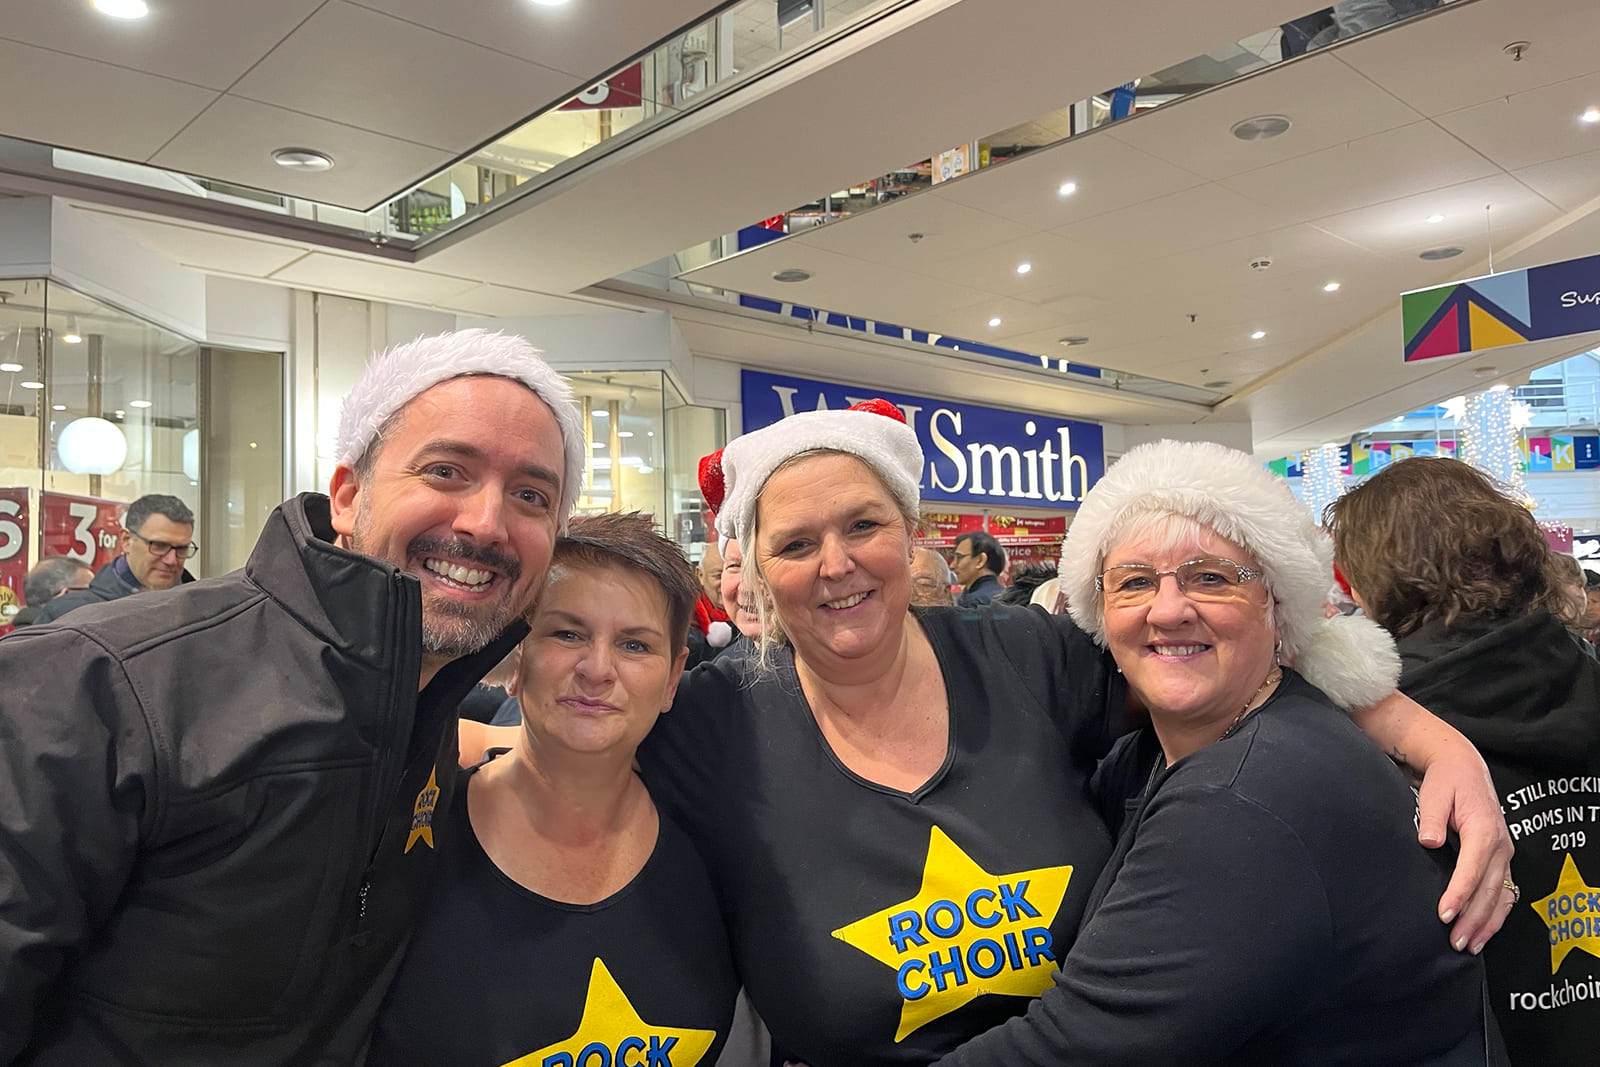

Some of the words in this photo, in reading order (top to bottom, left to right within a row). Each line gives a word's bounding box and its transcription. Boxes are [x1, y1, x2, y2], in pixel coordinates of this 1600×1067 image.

[98, 529, 118, 549] for
[1506, 782, 1547, 811] STILL
[1509, 808, 1564, 841] PROMS
[1566, 805, 1584, 823] IN
[1551, 830, 1586, 851] 2019
[888, 879, 1043, 955] ROCK
[897, 926, 1057, 1001] CHOIR
